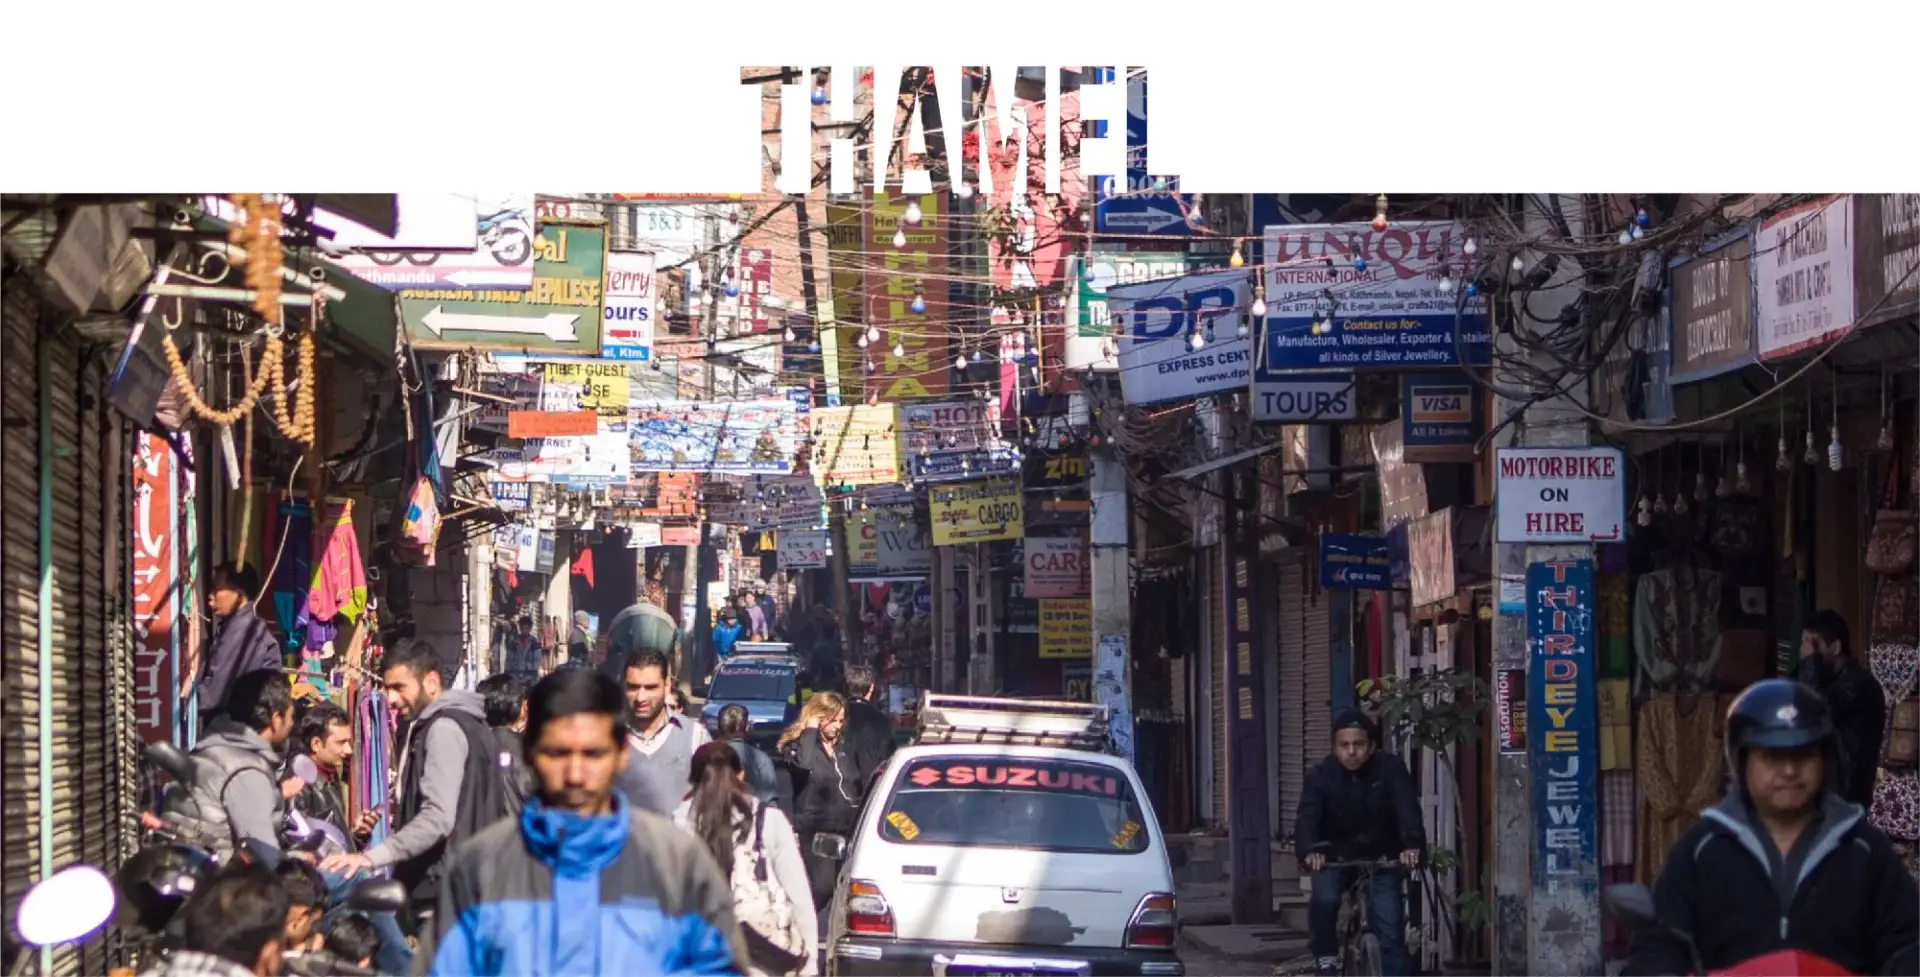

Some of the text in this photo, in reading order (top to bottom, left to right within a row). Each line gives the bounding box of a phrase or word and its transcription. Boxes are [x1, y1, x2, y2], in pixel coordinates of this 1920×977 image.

[1133, 287, 1235, 346] DP
[1343, 321, 1388, 331] Contact
[1390, 321, 1398, 330] us
[1401, 333, 1443, 345] Exporter
[1445, 332, 1452, 343] &
[1158, 353, 1215, 375] EXPRESS
[1319, 352, 1330, 363] all
[1332, 351, 1360, 362] kinds
[1361, 350, 1372, 361] of
[1374, 349, 1401, 361] Silver
[585, 363, 626, 377] GUEST
[1261, 391, 1348, 414] TOURS
[1421, 396, 1462, 412] VISA
[1500, 456, 1615, 479] MOTORBIKE
[1539, 487, 1569, 503] ON
[978, 502, 1019, 525] CARGO
[1526, 512, 1584, 535] HIRE
[1500, 671, 1509, 749] ABSOLUTION
[946, 766, 1117, 796] SUZUKI
